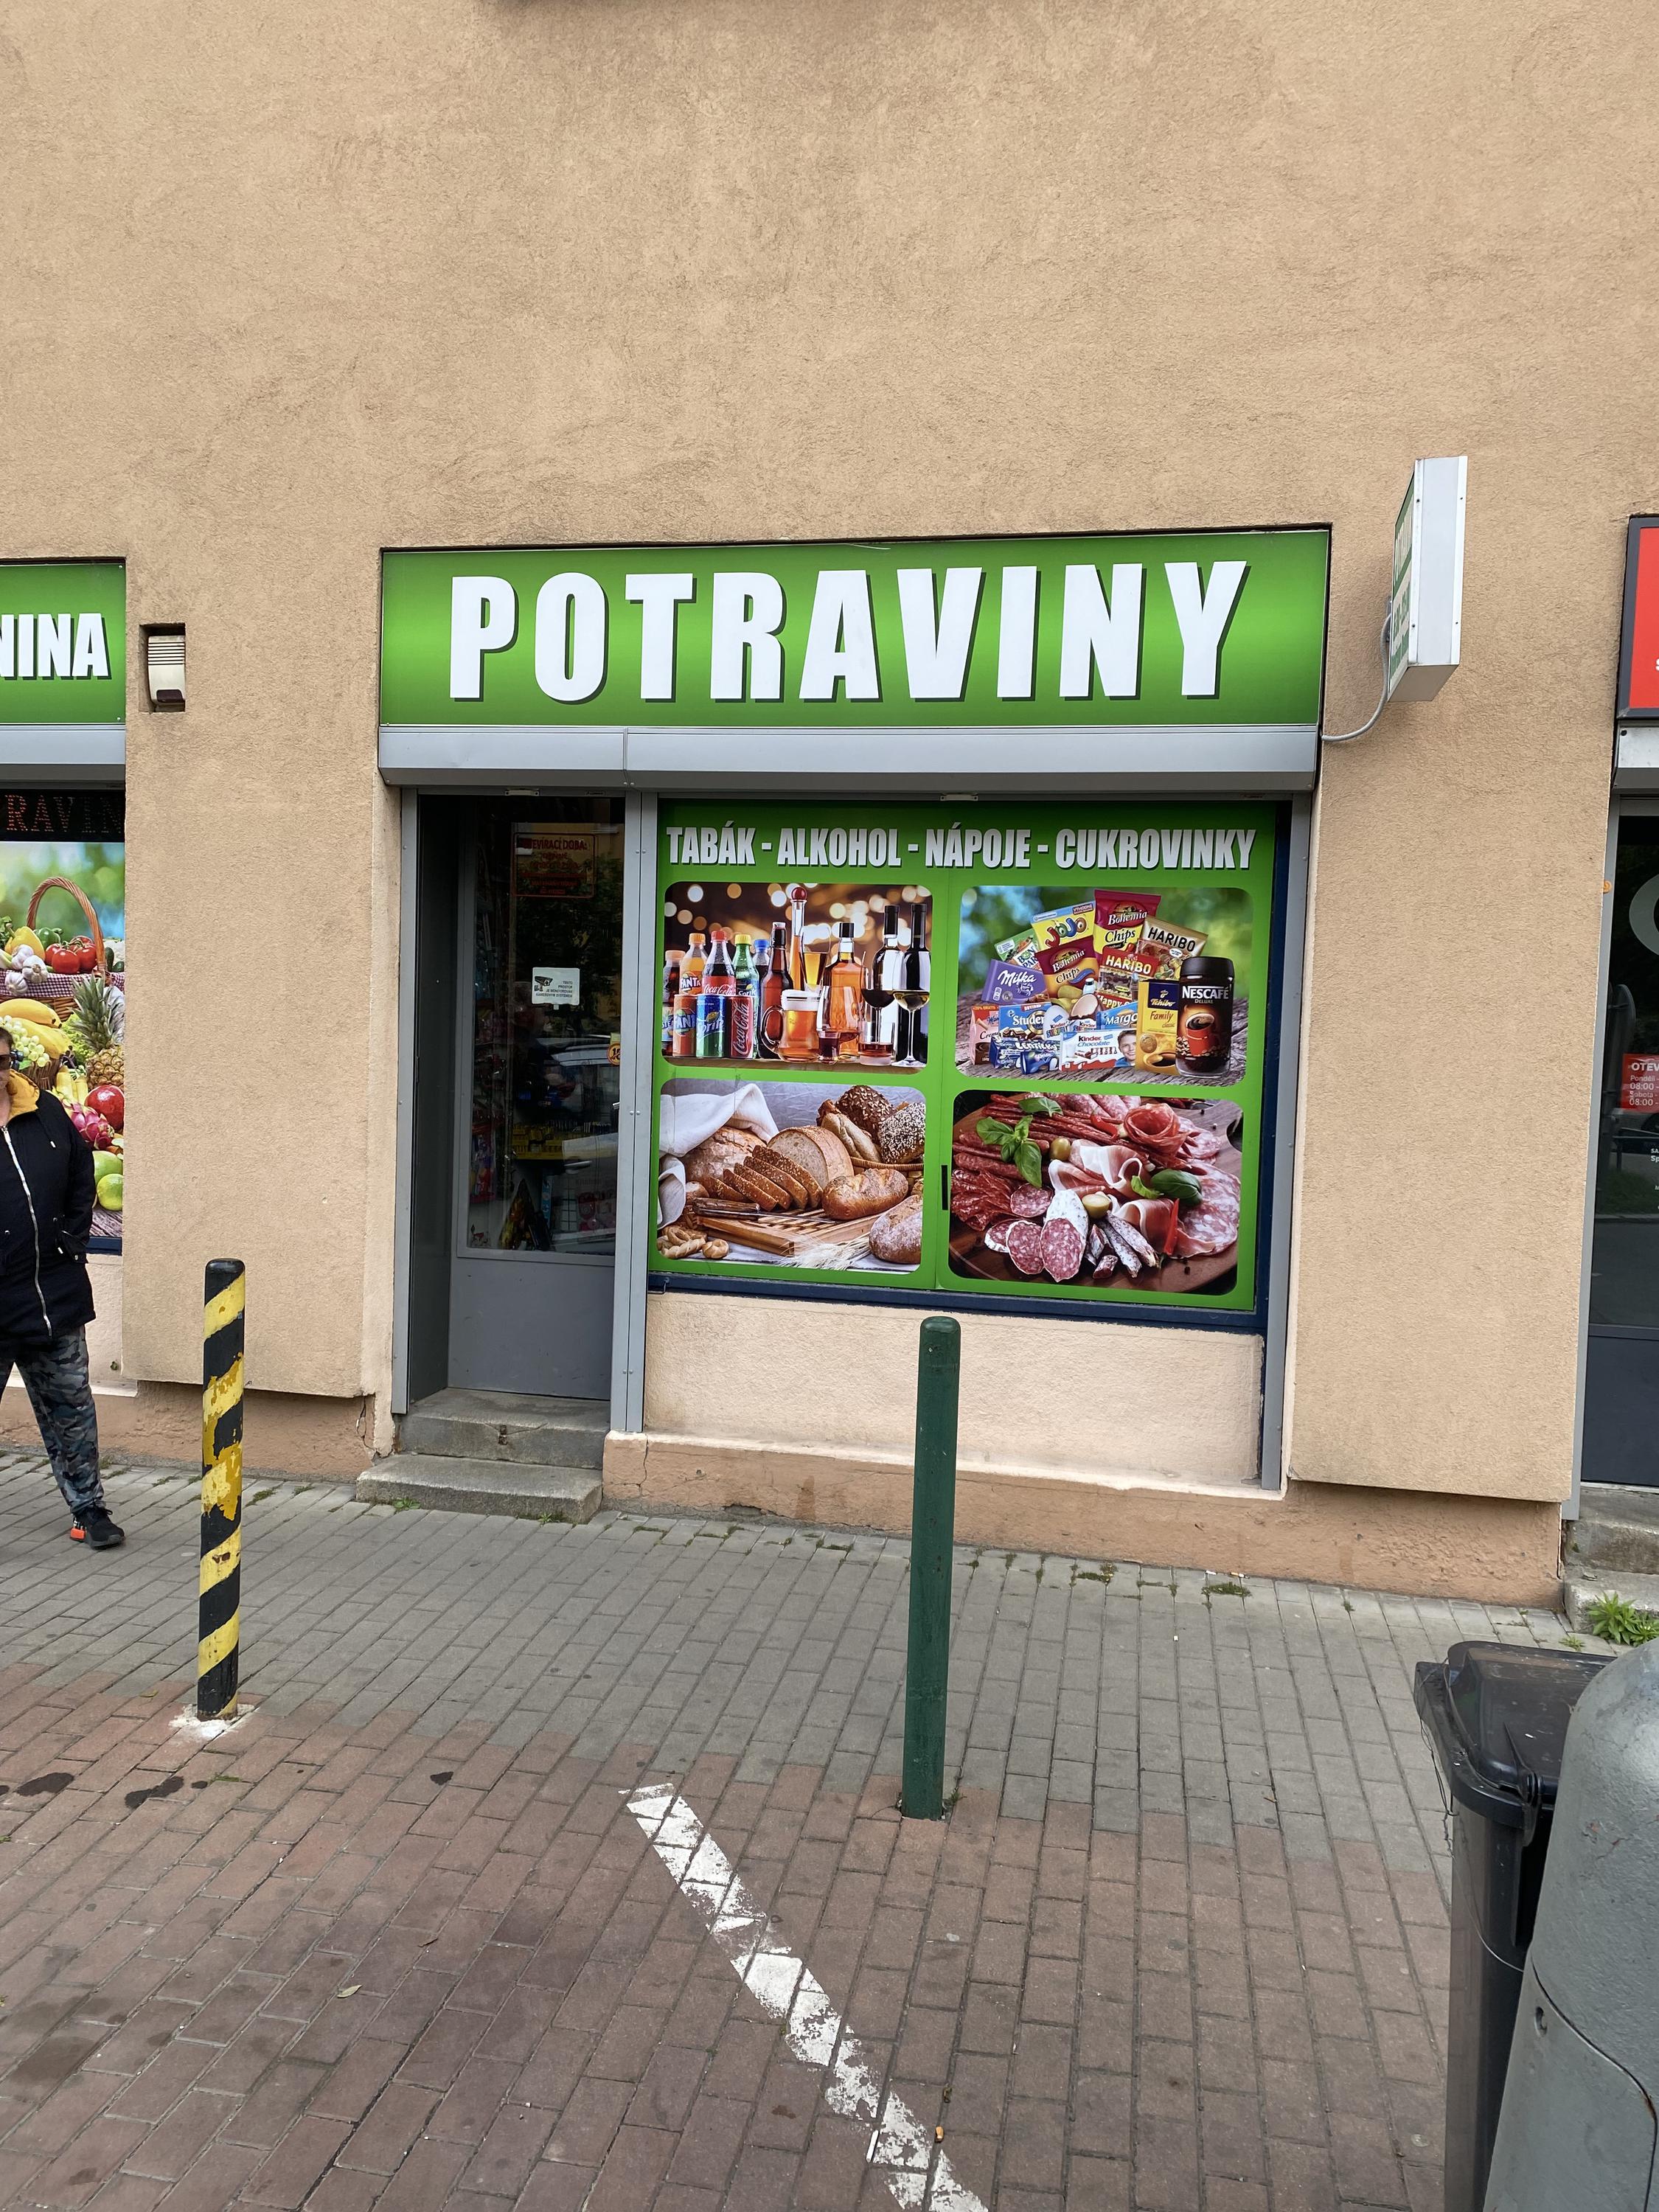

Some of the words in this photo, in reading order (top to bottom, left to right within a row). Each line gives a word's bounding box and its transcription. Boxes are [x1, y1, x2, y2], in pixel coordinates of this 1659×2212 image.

[450, 560, 1249, 701] POTRAVINY
[667, 821, 756, 865] TABÁK
[777, 827, 902, 867] ALKOHOL
[925, 821, 1032, 868] NÁPOJE
[1056, 829, 1256, 869] CUKROVINKY
[1105, 928, 1135, 944] Chips
[1147, 927, 1195, 952] HARIBO
[1106, 955, 1152, 975] HARIBO
[997, 970, 1037, 987] Milka
[1056, 966, 1080, 984] Chips
[1182, 986, 1229, 999] NESCAFÉ
[1150, 1010, 1174, 1023] Family
[1630, 1082, 1655, 1091] 08:00
[1629, 1098, 1654, 1106] 08:00
